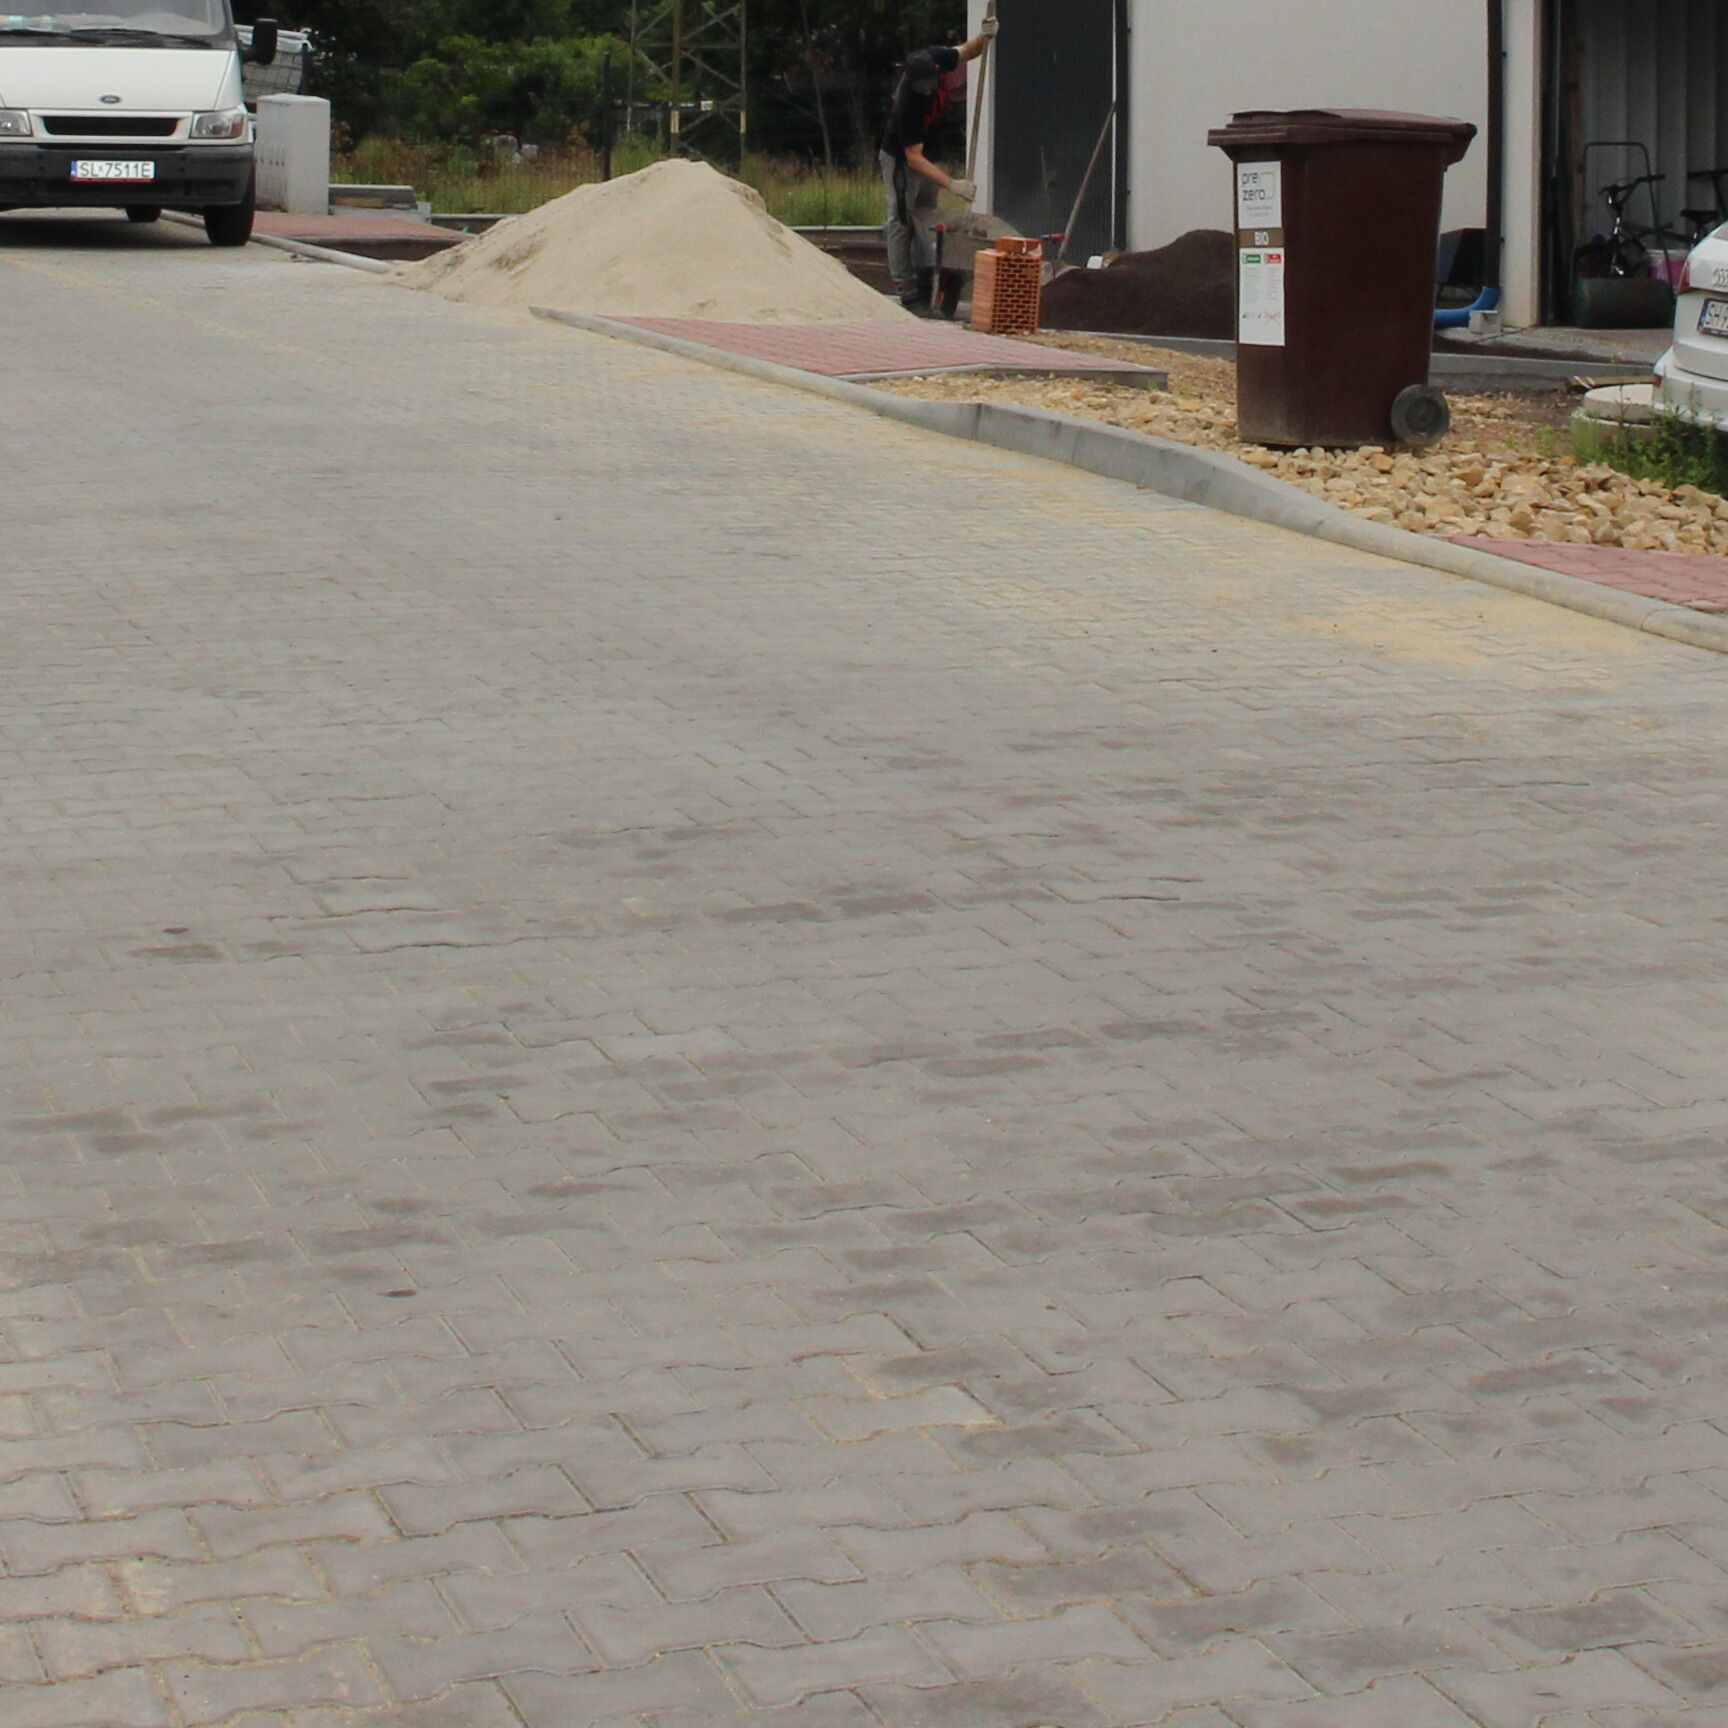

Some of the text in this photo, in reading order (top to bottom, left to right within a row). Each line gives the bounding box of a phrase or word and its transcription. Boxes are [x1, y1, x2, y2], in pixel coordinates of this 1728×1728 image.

[79, 162, 151, 178] SL 7511E
[1243, 189, 1266, 201] zero
